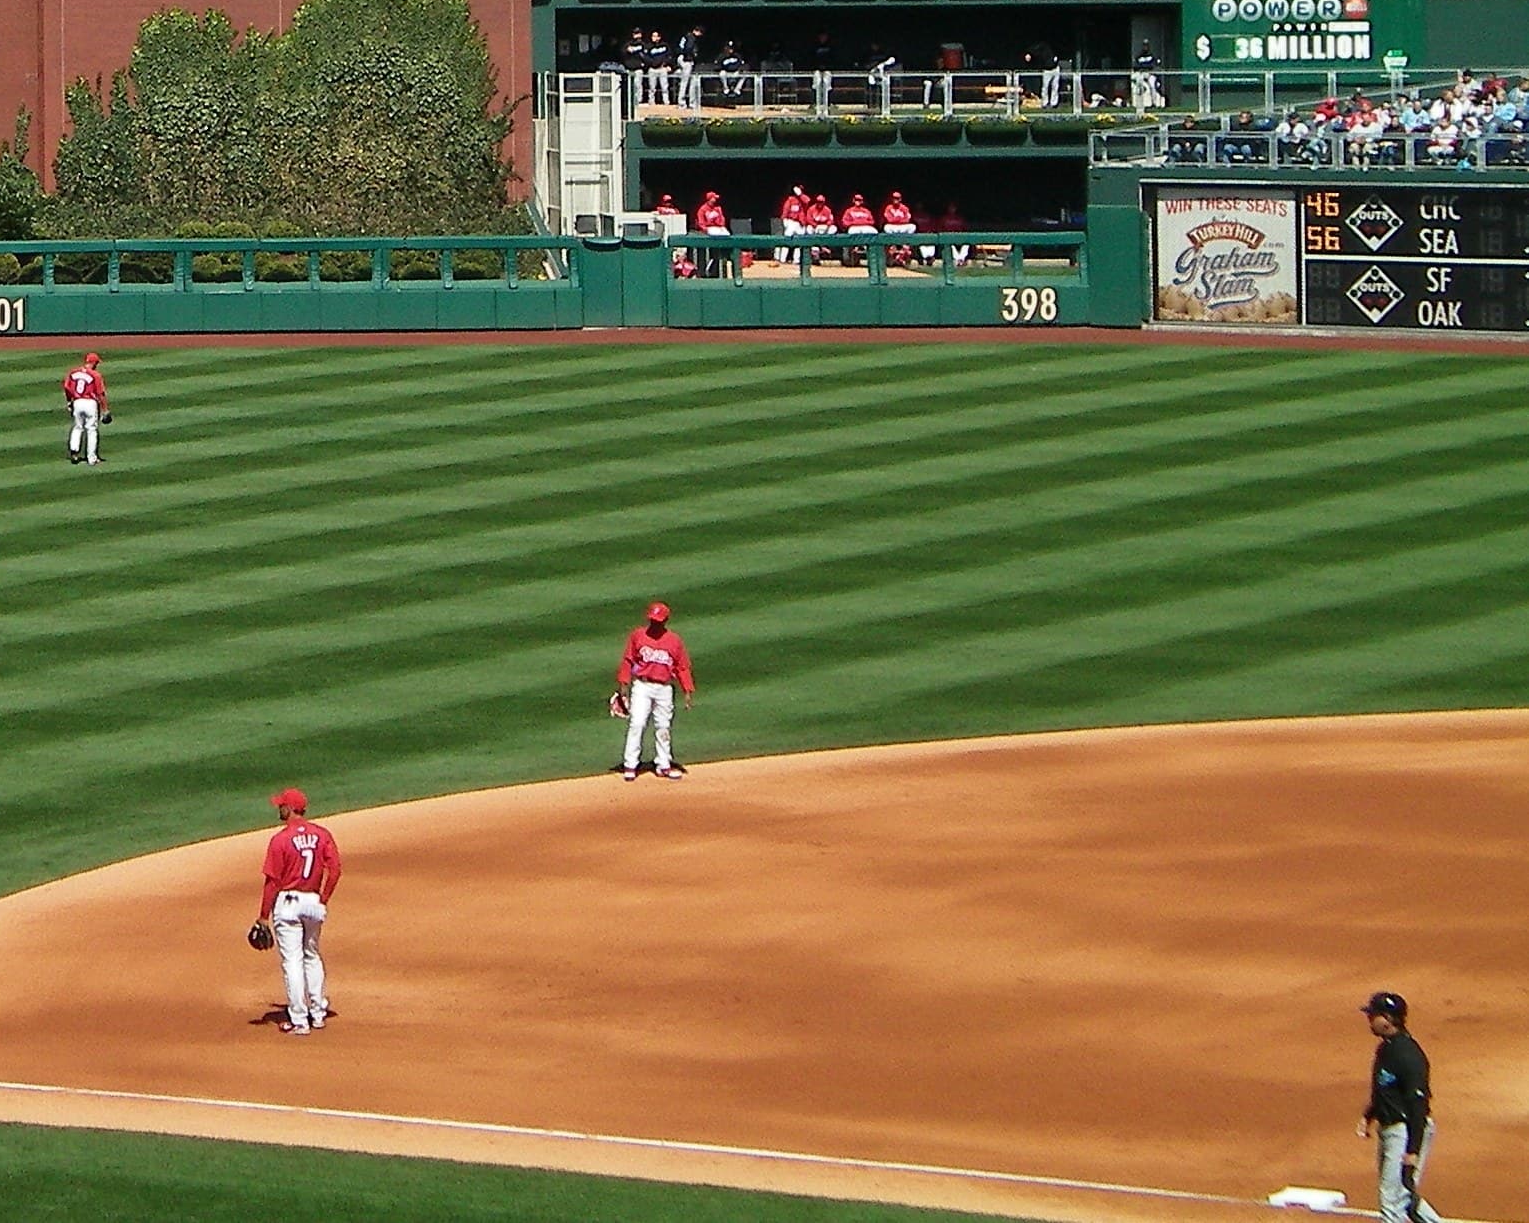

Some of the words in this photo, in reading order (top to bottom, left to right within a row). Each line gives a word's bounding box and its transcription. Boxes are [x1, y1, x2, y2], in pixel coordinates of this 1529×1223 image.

[1215, 0, 1339, 18] POWER
[1196, 35, 1211, 60] $
[1234, 37, 1263, 59] 36
[1267, 35, 1370, 60] MILLION
[1165, 199, 1192, 214] WIN
[1199, 198, 1240, 210] THESE
[1246, 200, 1288, 217] SEATS
[1307, 193, 1340, 216] 46
[1359, 210, 1389, 220] OUTS
[1420, 195, 1461, 220] CHC
[1191, 225, 1234, 243] TURKEY
[1235, 226, 1259, 244] HILL
[1307, 226, 1341, 251] 56
[1419, 229, 1459, 254] SEA
[1173, 247, 1280, 285] Graham
[1194, 270, 1259, 308] Slam
[1360, 283, 1390, 293] OUTS
[1426, 267, 1452, 293] SF
[1002, 287, 1057, 321] 398
[1418, 301, 1462, 326] OAK
[292, 834, 319, 850] FELIZ
[301, 849, 313, 878] 7
